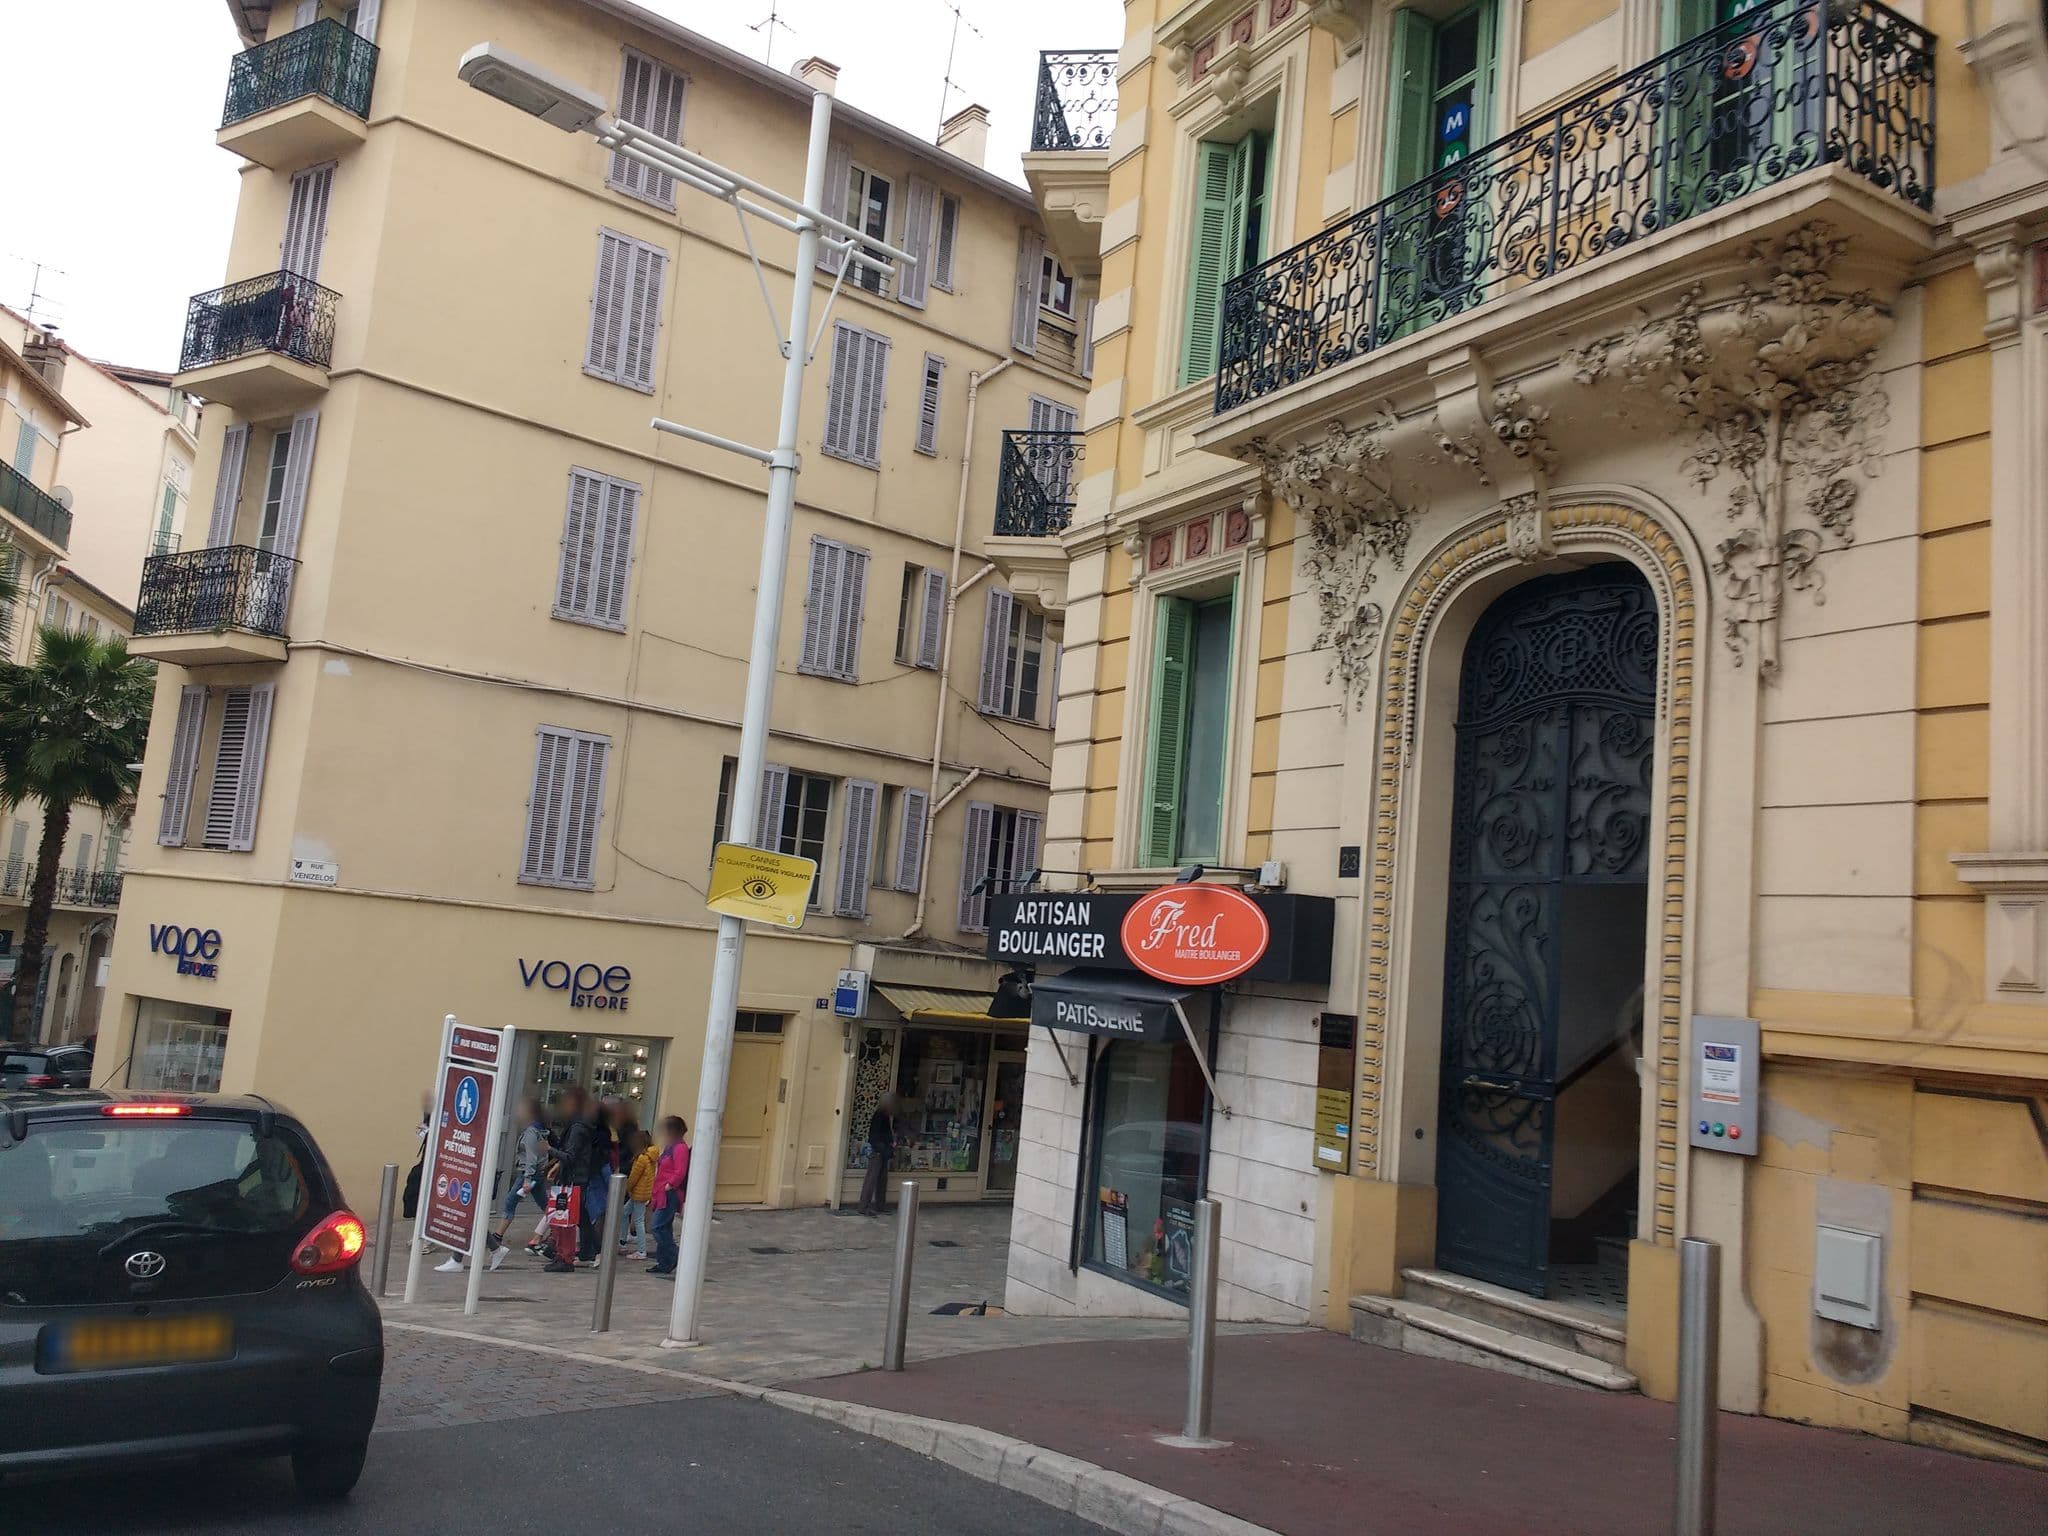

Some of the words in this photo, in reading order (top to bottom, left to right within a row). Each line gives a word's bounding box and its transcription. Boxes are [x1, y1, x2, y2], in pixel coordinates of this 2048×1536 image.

[1445, 111, 1463, 134] M
[726, 858, 755, 869] QUARTIER
[755, 865, 780, 875] VOISINS
[780, 870, 811, 881] VIGILANTS
[750, 854, 781, 867] CANNES
[294, 872, 335, 882] VENIZELOS
[1014, 901, 1090, 926] ARTISAN
[1141, 900, 1224, 950] Fred
[150, 923, 222, 974] vape
[998, 929, 1105, 958] BOULANGER
[1199, 950, 1241, 961] BOULANGER
[518, 958, 631, 1007] vape
[575, 994, 629, 1010] STORE
[1056, 1001, 1145, 1033] PATISSERIE
[452, 1129, 472, 1143] ZONE
